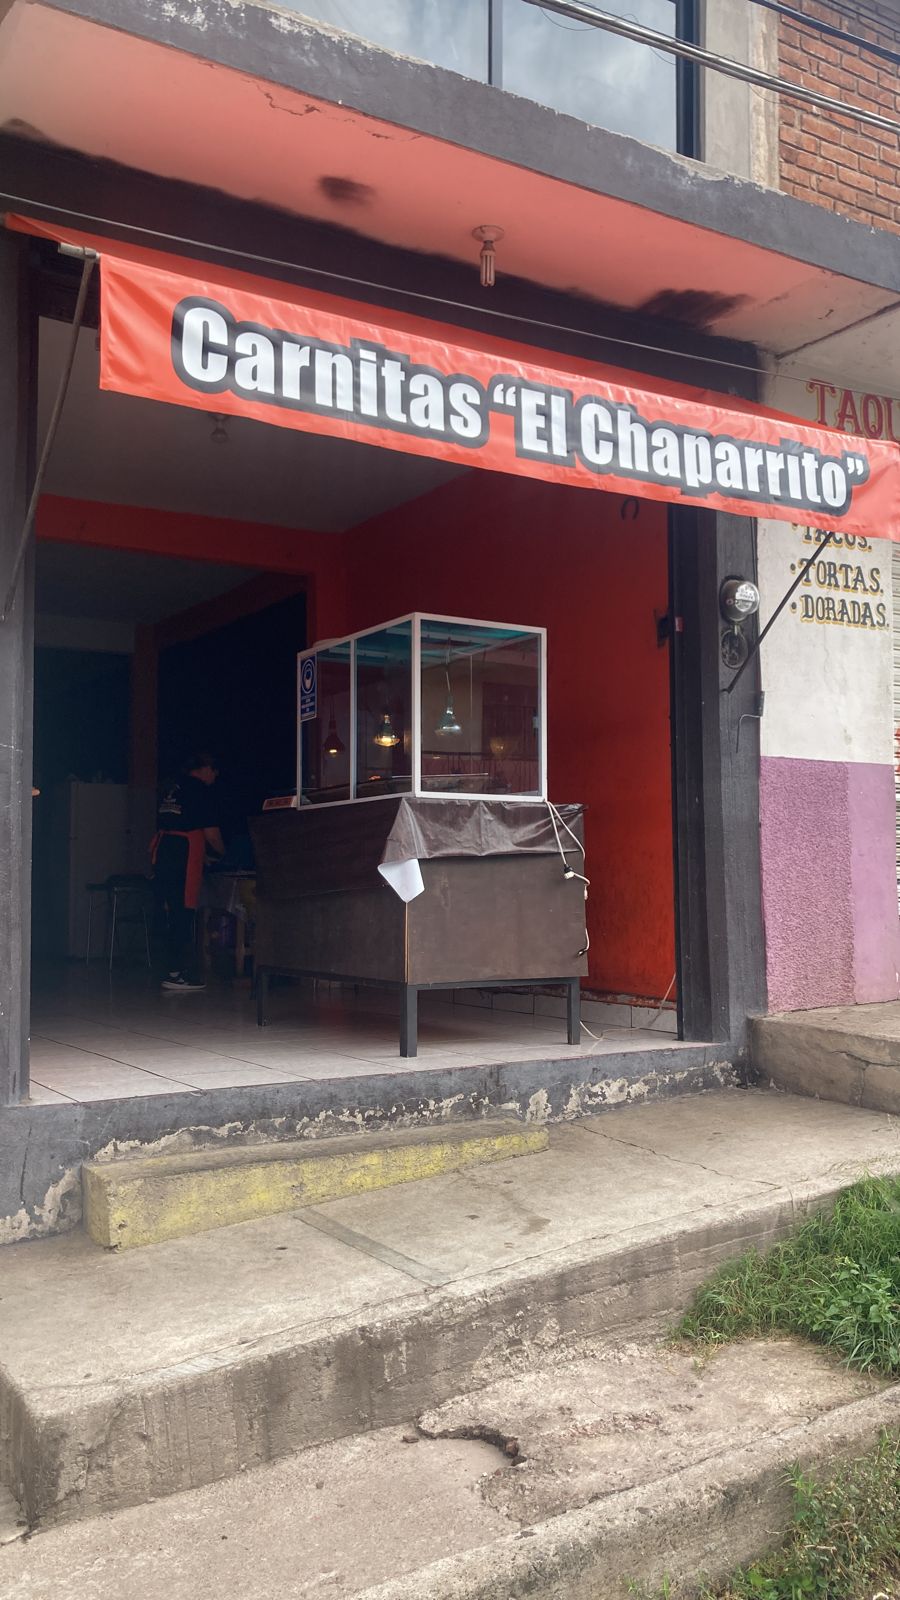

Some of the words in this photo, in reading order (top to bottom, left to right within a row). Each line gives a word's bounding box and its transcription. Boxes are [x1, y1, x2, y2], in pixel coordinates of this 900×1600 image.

[182, 307, 482, 438] Carnitas
[493, 383, 568, 457] “El
[579, 402, 864, 508] Chaparrito”
[799, 558, 884, 595] TORTAS.
[800, 595, 890, 628] DORADAS.
